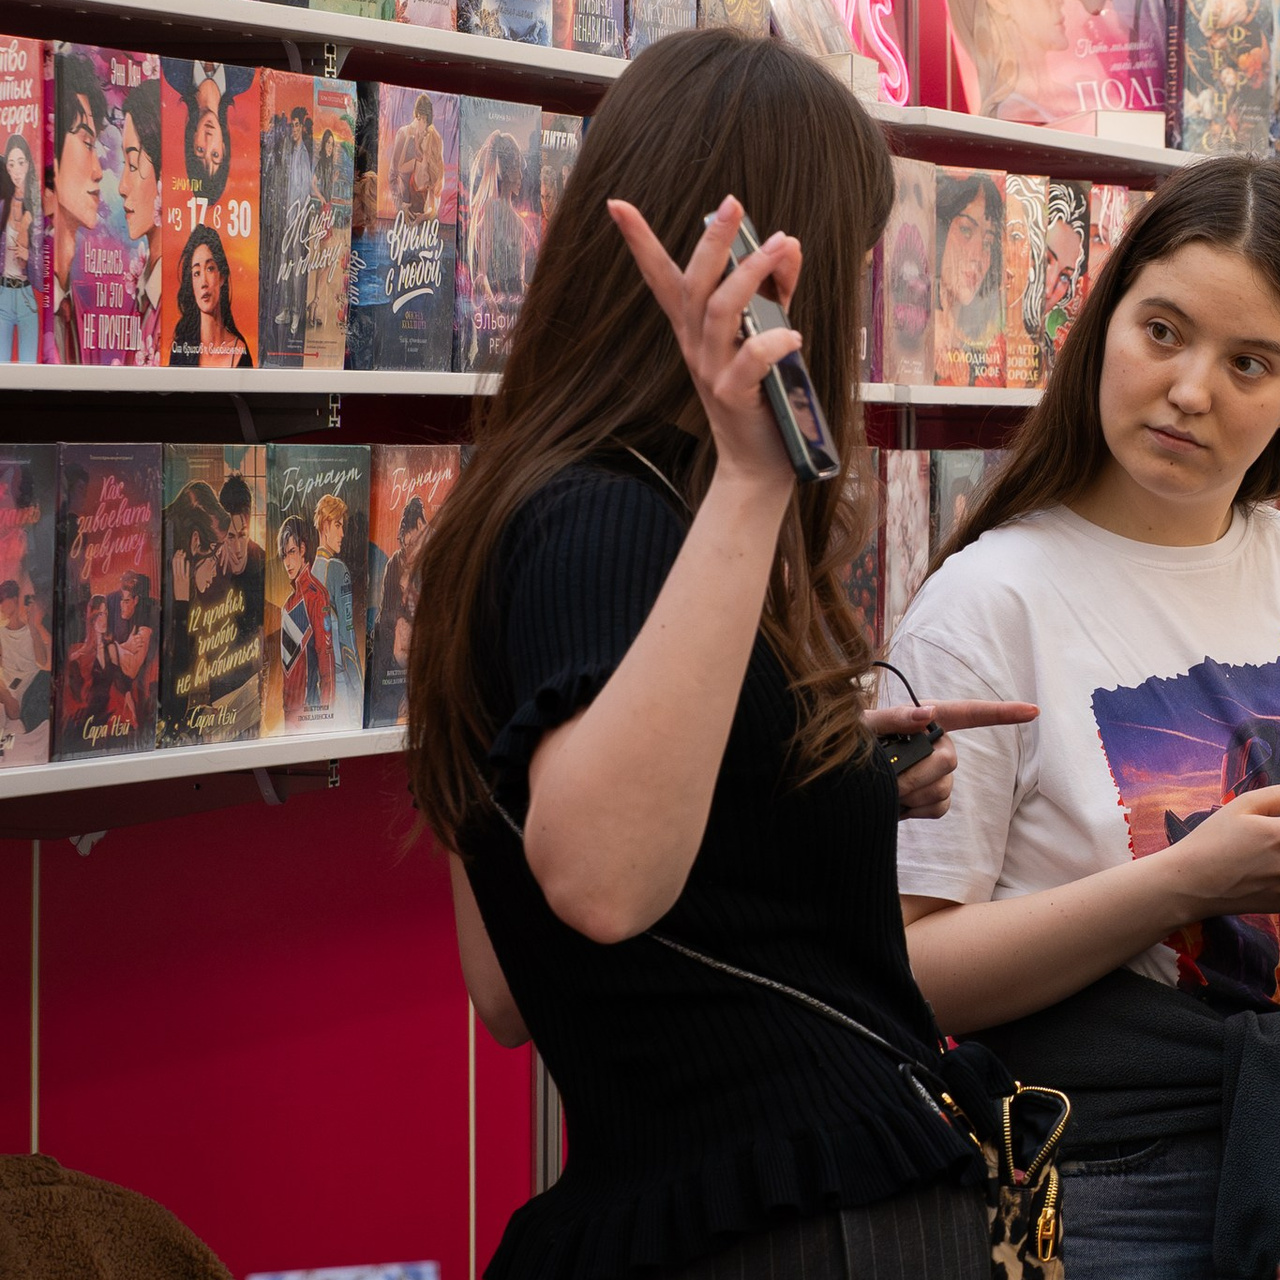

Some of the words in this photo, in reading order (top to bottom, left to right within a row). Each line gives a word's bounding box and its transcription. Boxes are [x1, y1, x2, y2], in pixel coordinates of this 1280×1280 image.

[573, 13, 619, 46] НЕНАВИДЕТЬ
[0, 103, 39, 135] ердец
[541, 129, 578, 150] ДИТЕЛЬ
[187, 197, 209, 234] 17
[227, 199, 251, 238] 30
[281, 194, 337, 255] Жизнь
[386, 210, 440, 266] Время
[385, 269, 395, 296] с
[397, 249, 443, 289] тобой
[83, 313, 97, 350] НЕ
[974, 366, 1000, 378] КОФЕ
[101, 474, 124, 500] Как
[70, 501, 151, 559] завоевать
[81, 529, 147, 580] девушку
[188, 609, 199, 633] 12
[198, 621, 238, 657] чтобы
[176, 678, 192, 697] не
[194, 636, 260, 692] влюбиться
[82, 717, 108, 747] Сара
[110, 715, 131, 738] Нэй
[189, 707, 214, 737] Сара
[215, 708, 237, 726] Нэй
